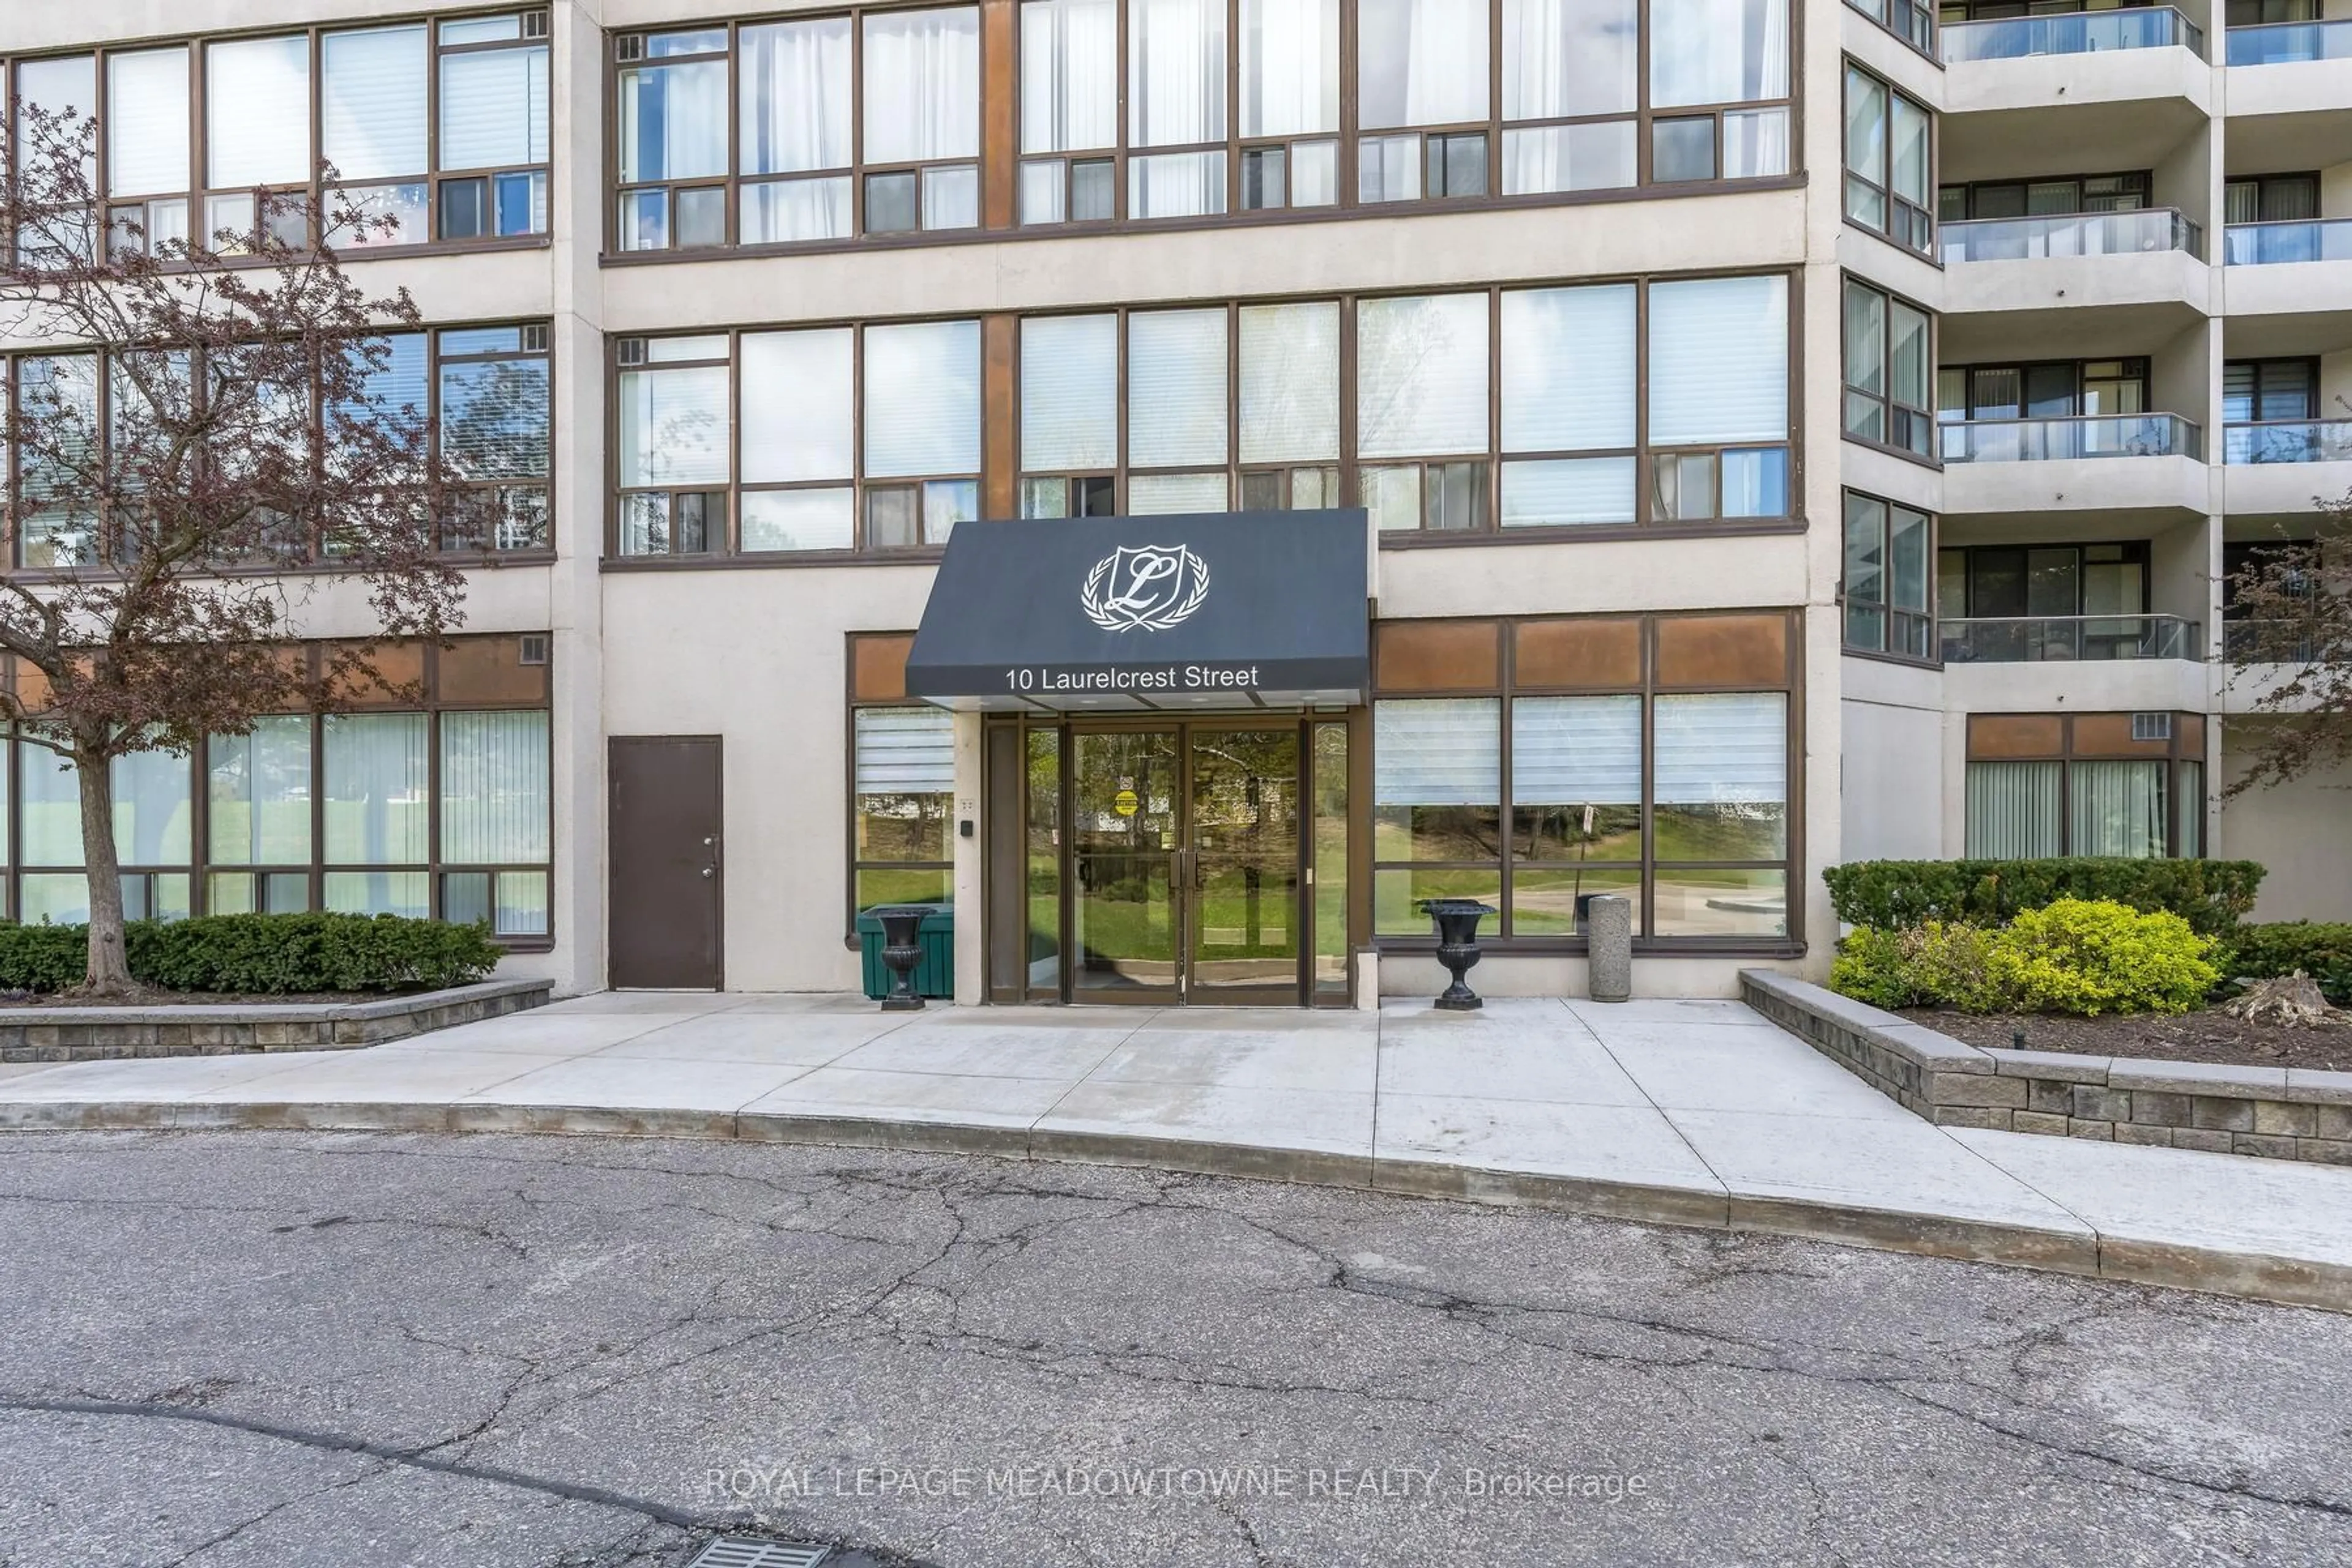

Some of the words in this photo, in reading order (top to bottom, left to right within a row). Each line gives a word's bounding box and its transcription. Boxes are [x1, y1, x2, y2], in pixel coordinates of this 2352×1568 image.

[1006, 669, 1033, 690] 10
[1042, 667, 1176, 689] Laurelcrest
[1185, 665, 1259, 687] Street
